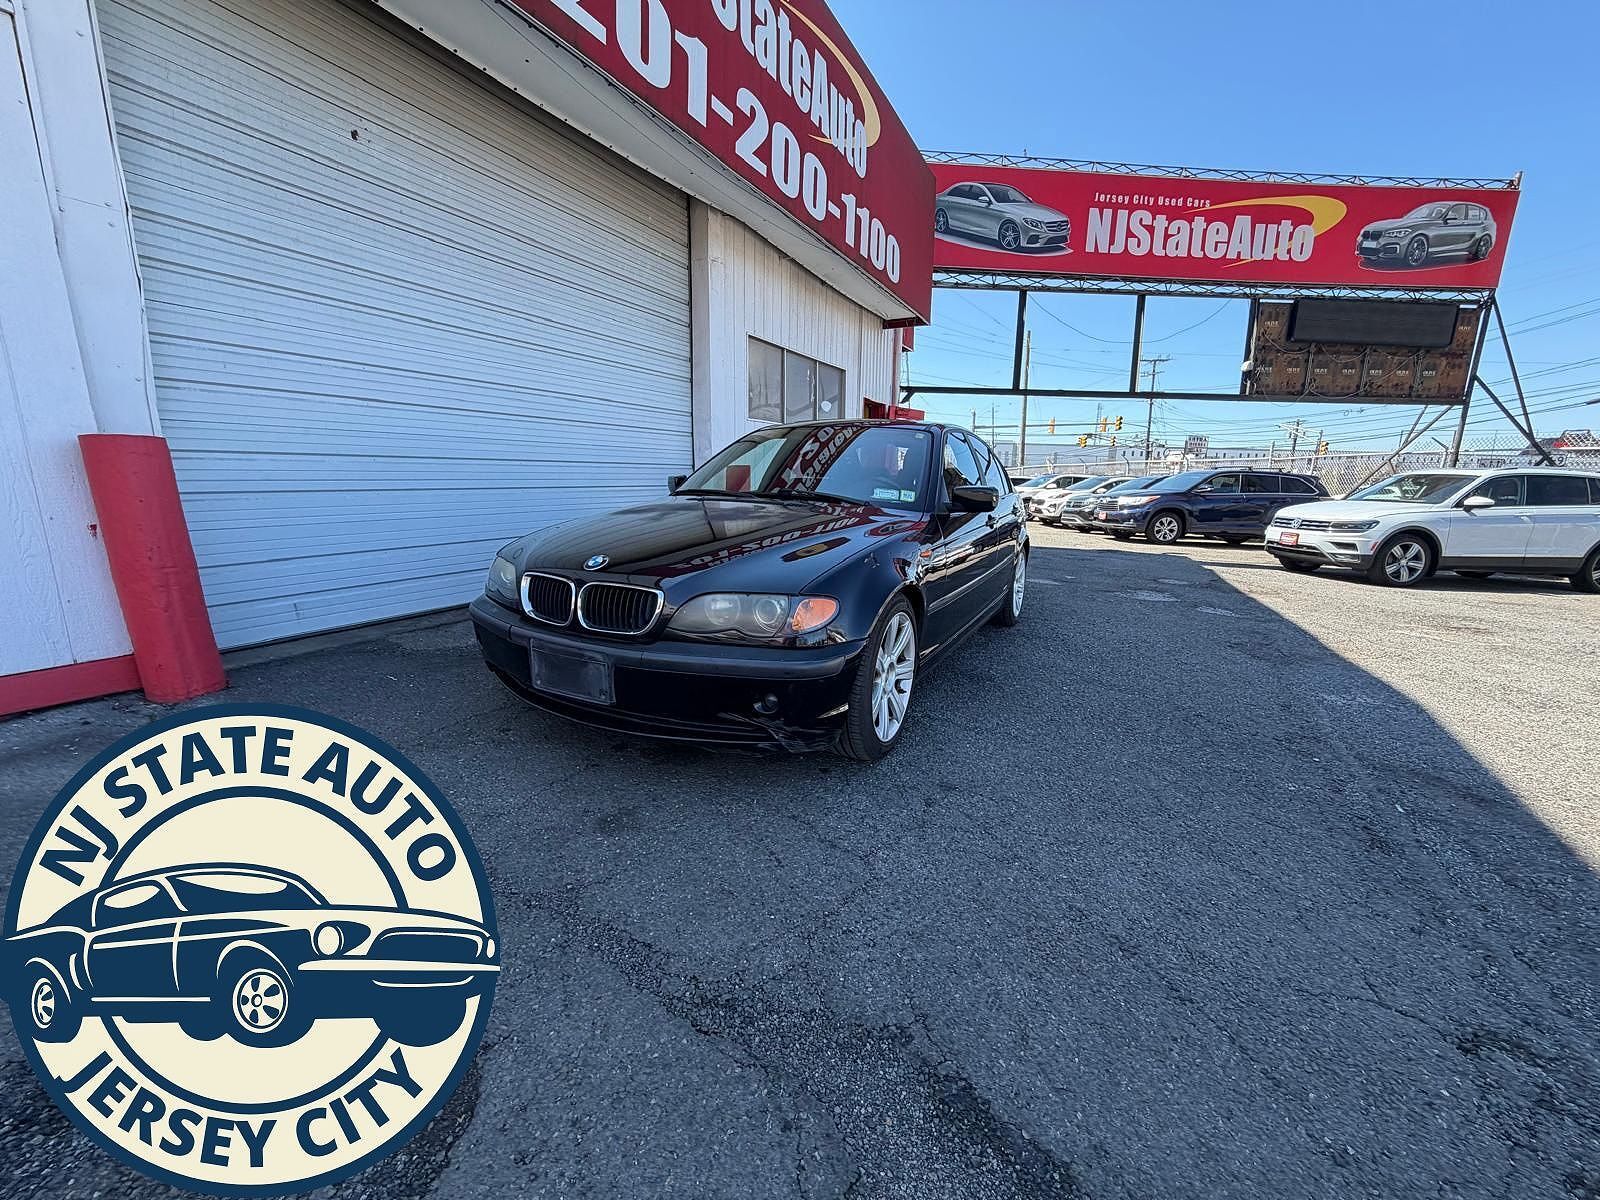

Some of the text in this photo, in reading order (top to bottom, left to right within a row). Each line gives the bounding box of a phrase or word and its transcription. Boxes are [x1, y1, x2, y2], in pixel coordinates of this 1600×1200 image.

[1094, 192, 1211, 208] Jersey City Used Cars
[1085, 207, 1316, 262] NJStateAuto
